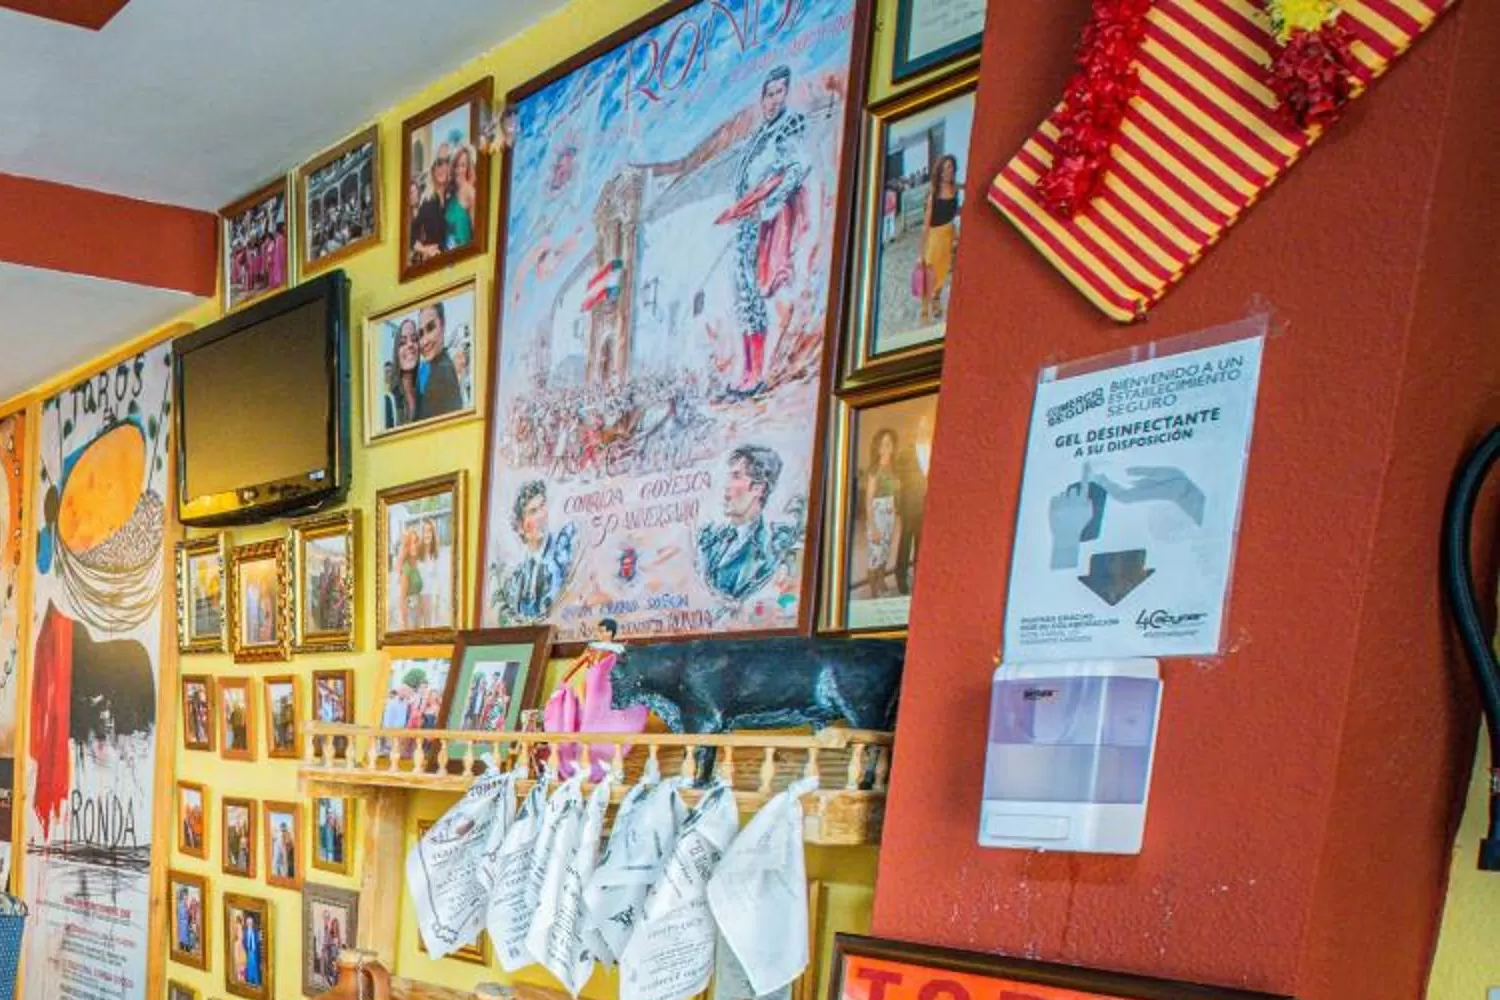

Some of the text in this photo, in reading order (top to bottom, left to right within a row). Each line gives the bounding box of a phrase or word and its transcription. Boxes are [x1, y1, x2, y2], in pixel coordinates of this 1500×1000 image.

[1107, 368, 1242, 404] ESTABLECIMIENTO
[1109, 355, 1244, 392] BIENVENIDO A UN
[1107, 394, 1177, 417] SEGURO
[1055, 407, 1221, 448] GEL DESINFECTANTE
[1074, 428, 1193, 457] A SU DISPOSICIÓN
[70, 789, 137, 849] RONDA
